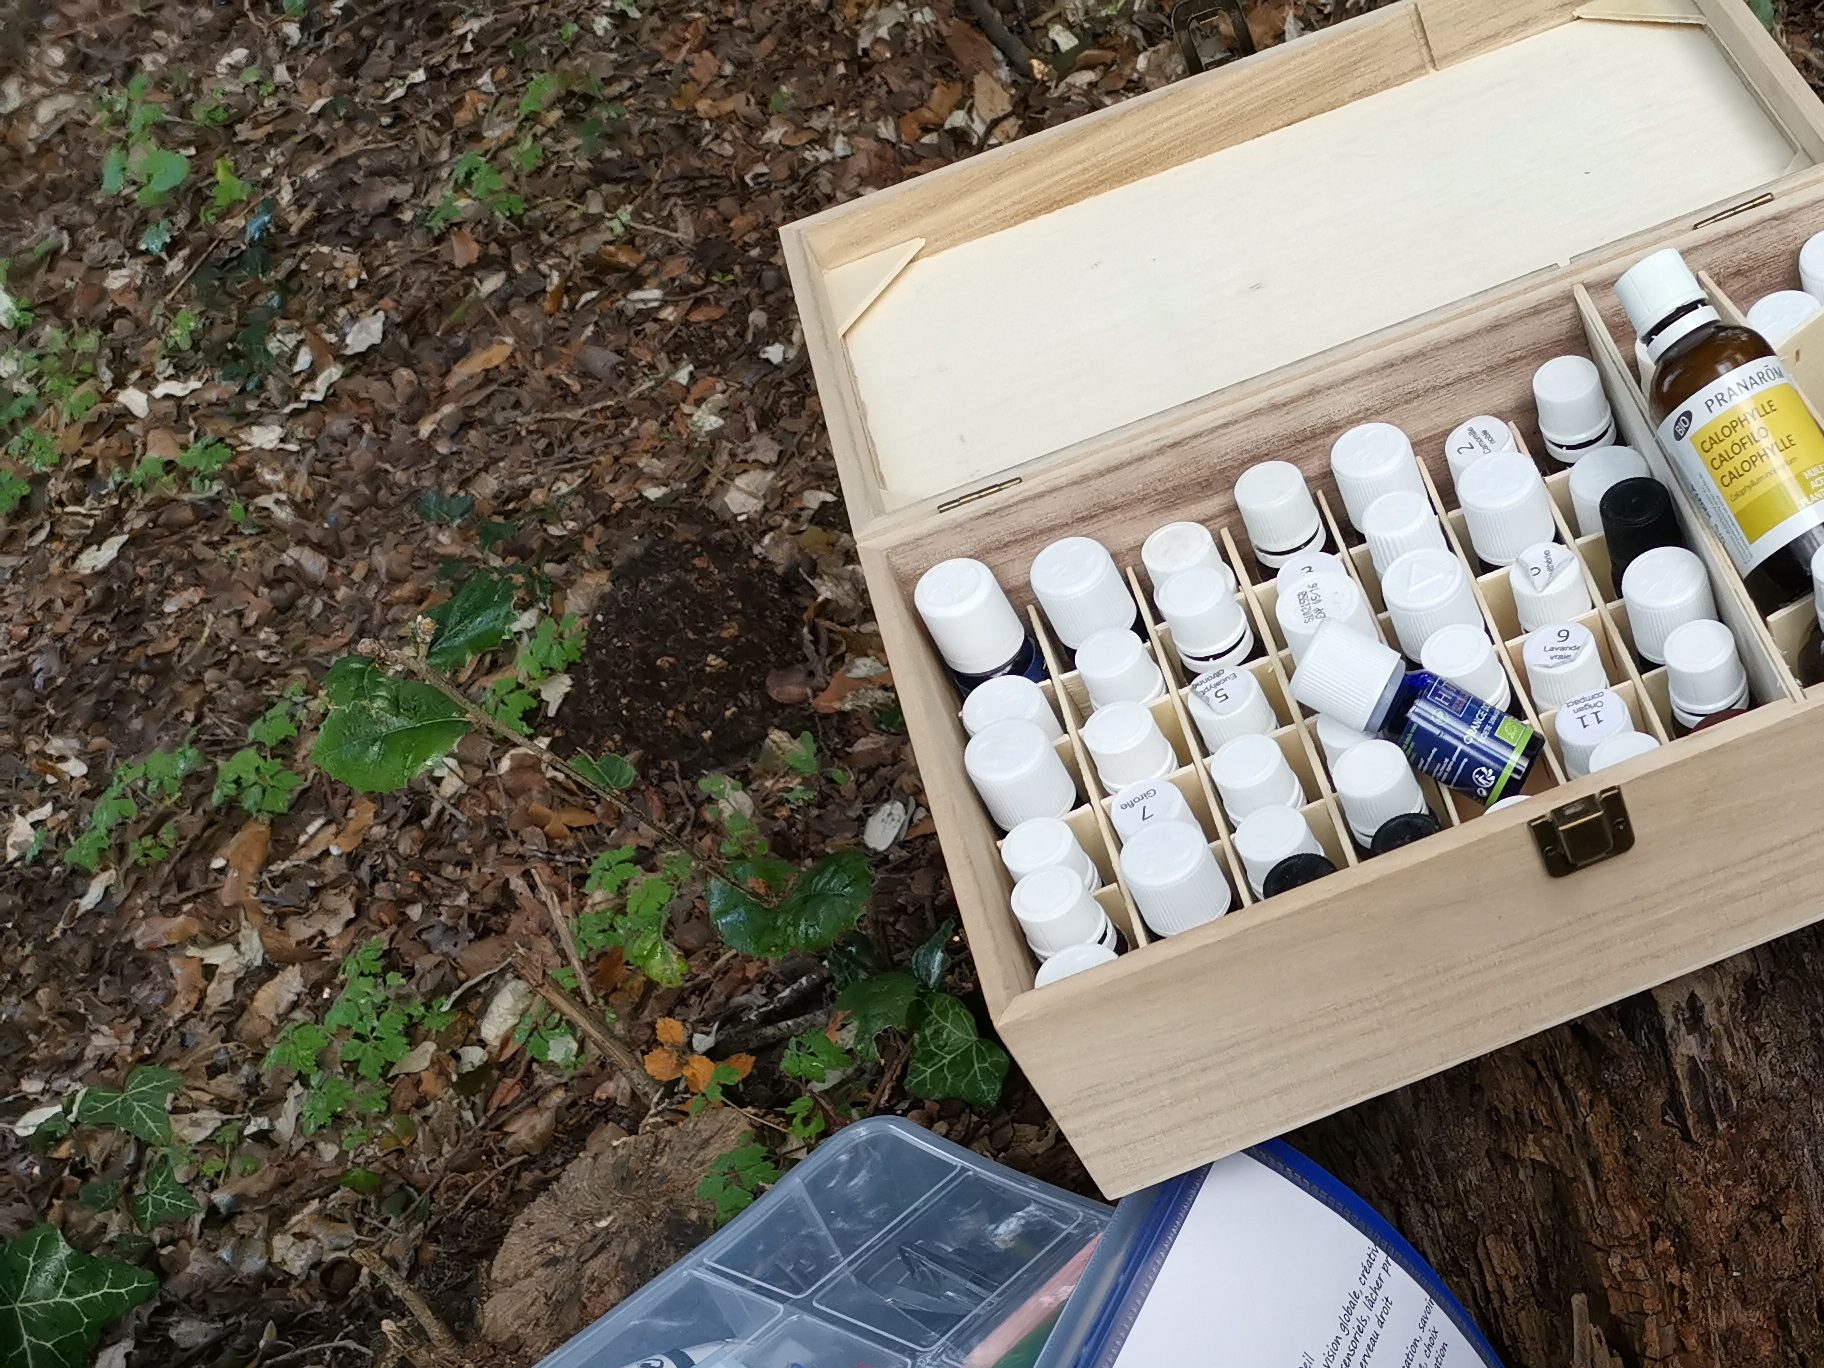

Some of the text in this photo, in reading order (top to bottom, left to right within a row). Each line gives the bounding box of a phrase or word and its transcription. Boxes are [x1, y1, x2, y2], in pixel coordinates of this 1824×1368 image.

[1675, 416, 1689, 436] BIO
[1700, 399, 1778, 454] CALOPHYLLE
[1457, 442, 1475, 455] 2
[1710, 426, 1769, 471] CALÓFILO
[1720, 434, 1796, 488] CALOPHYLLE
[1557, 629, 1570, 643] 9
[1214, 688, 1229, 704] 5
[1565, 691, 1605, 708] compact
[1573, 700, 1604, 714] Origan
[1576, 711, 1605, 729] 11
[1120, 788, 1157, 810] Girofle
[1140, 805, 1154, 821] 7
